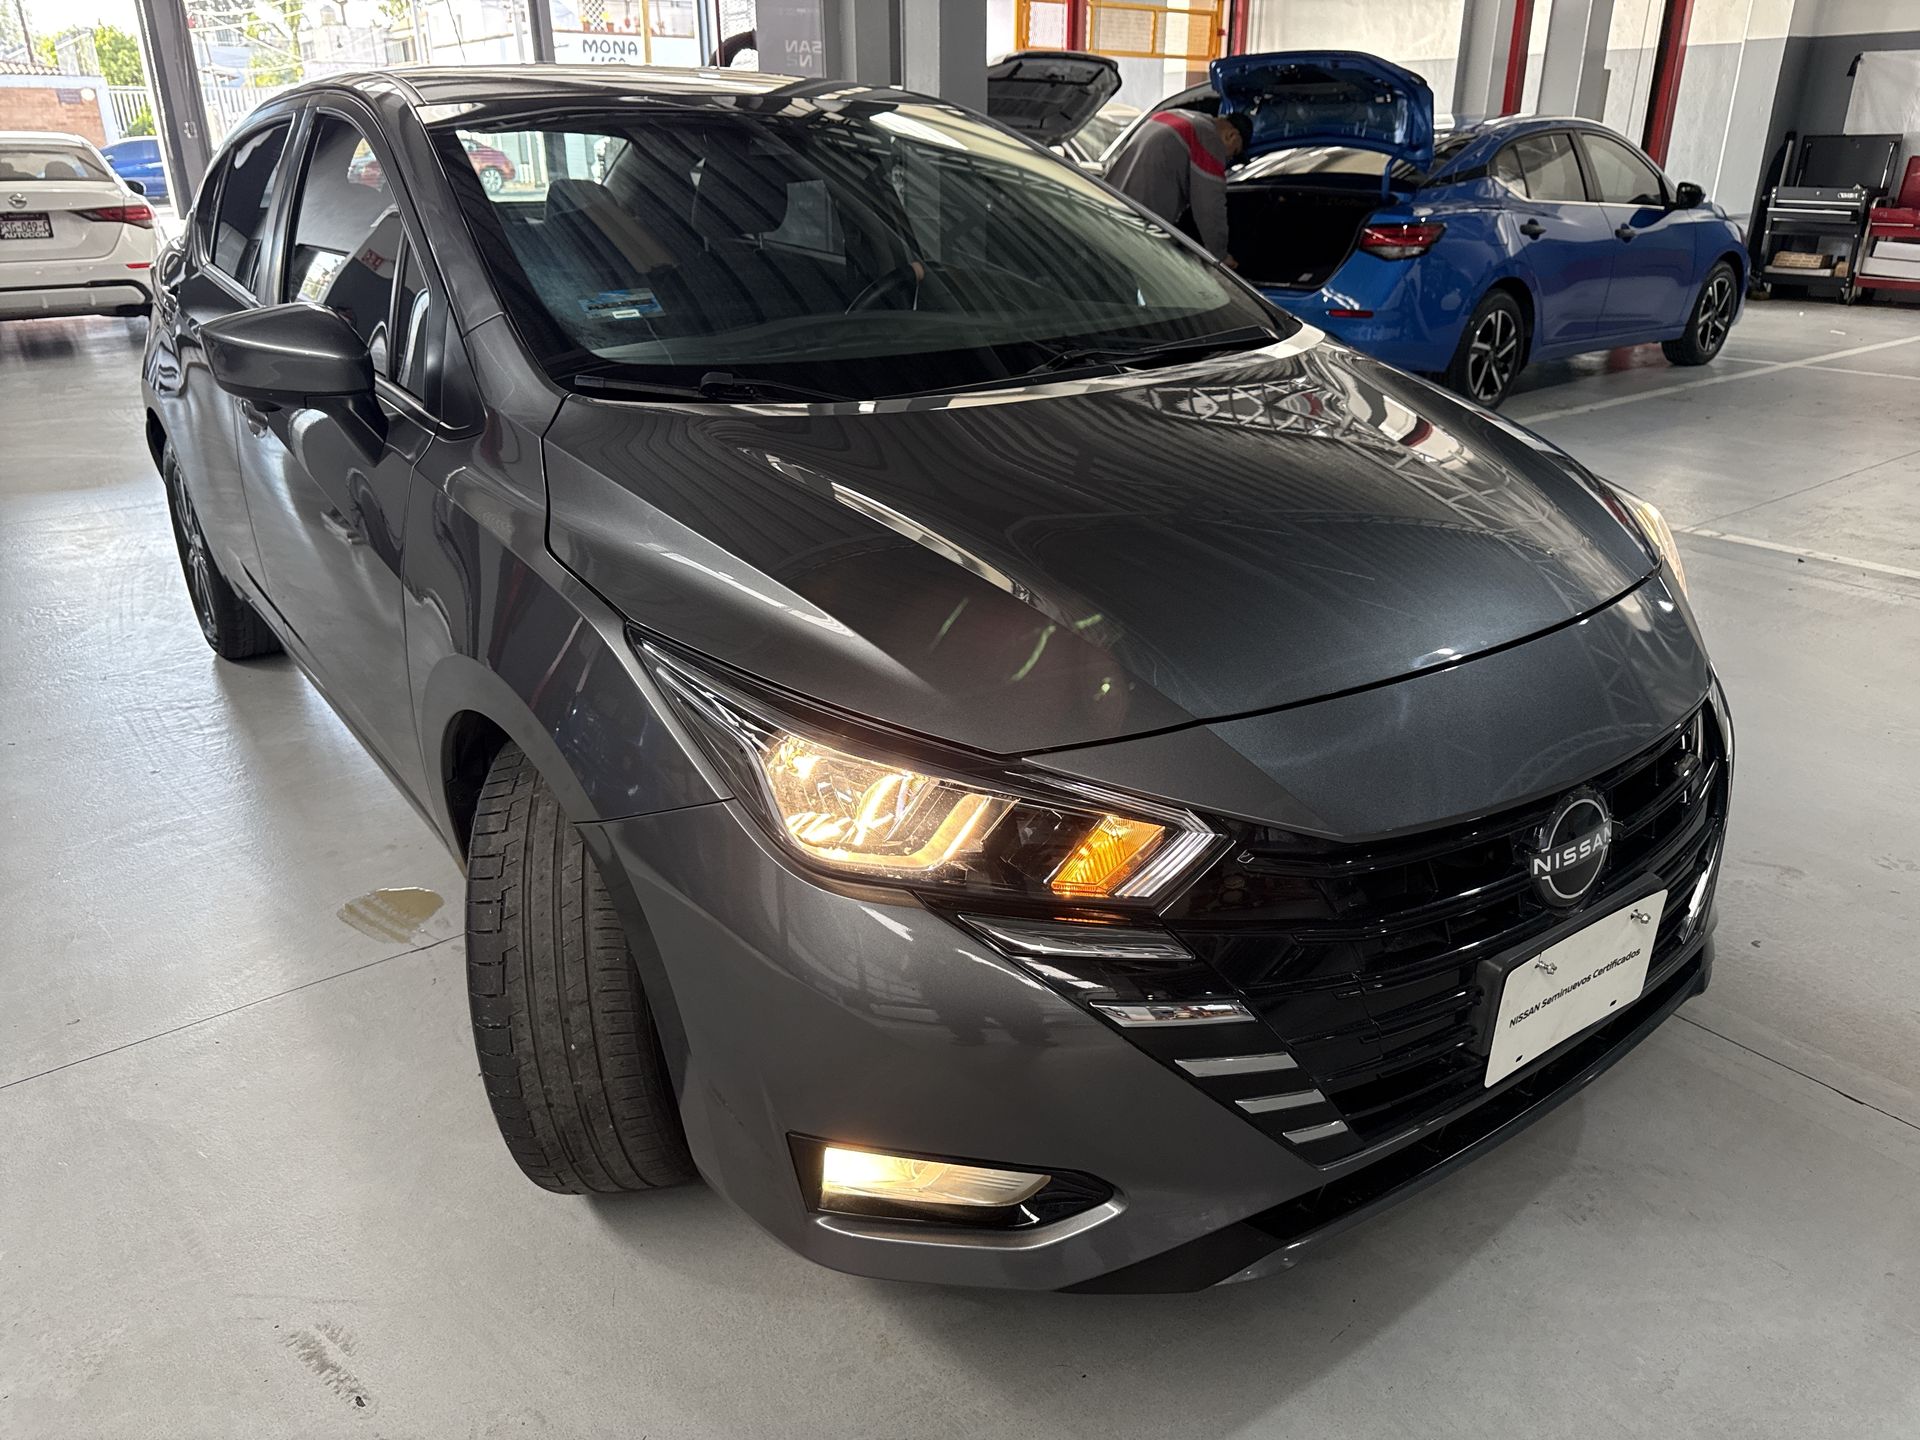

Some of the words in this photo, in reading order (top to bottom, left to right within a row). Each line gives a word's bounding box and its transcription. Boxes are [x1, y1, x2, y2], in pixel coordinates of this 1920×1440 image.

[582, 39, 638, 56] MONA
[1533, 826, 1611, 875] NISSAN
[1509, 1002, 1541, 1028] NISSAN
[1540, 974, 1592, 1009] Seminuevos
[1592, 948, 1641, 979] Certificados
